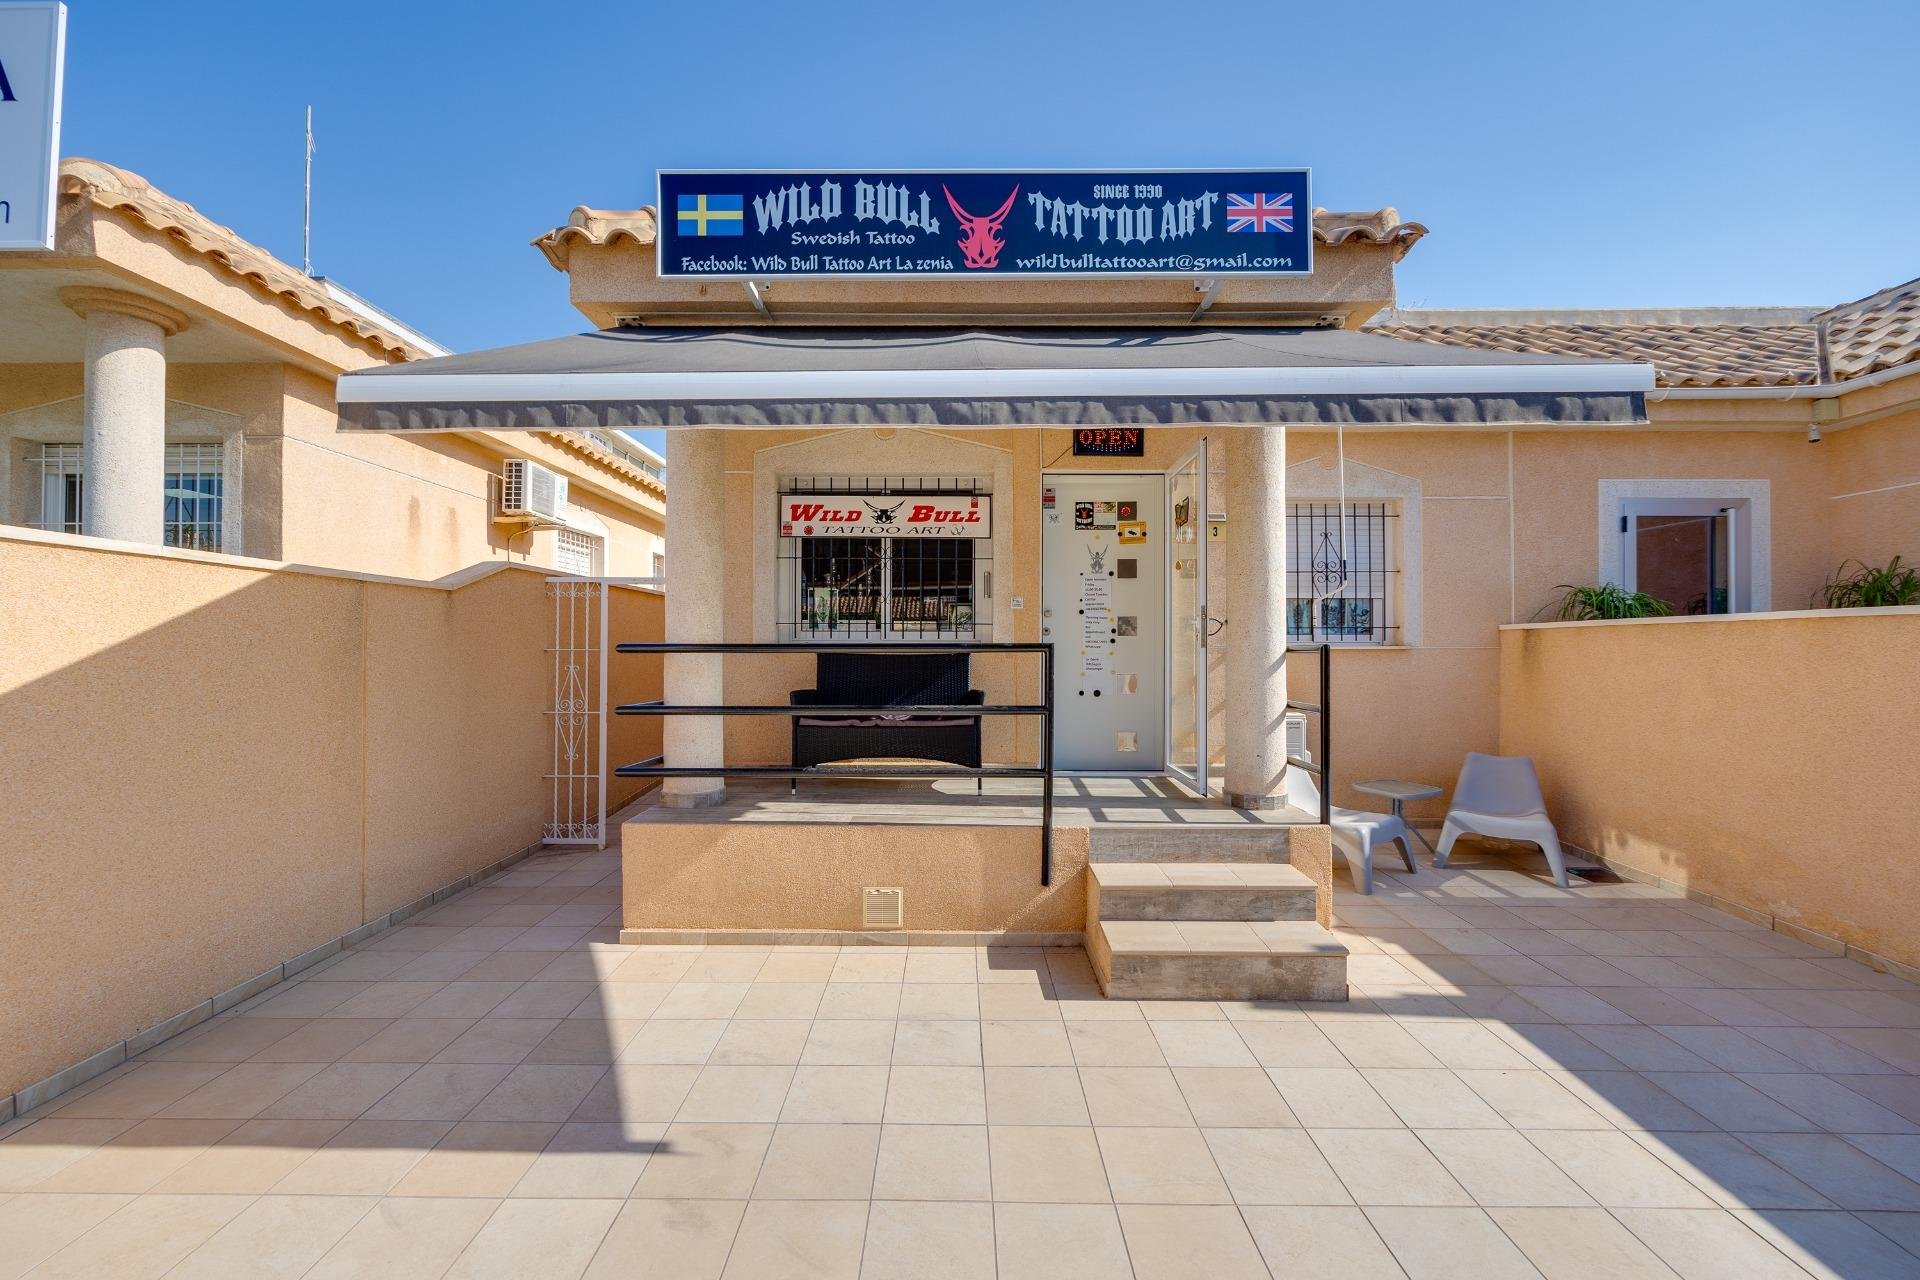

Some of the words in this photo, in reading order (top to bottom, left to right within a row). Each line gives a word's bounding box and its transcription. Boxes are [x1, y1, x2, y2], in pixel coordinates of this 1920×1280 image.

[1093, 183, 1130, 199] SINCE
[1133, 183, 1163, 199] 1990
[752, 178, 842, 236] WILD
[853, 178, 940, 235] BULL
[1027, 190, 1154, 246] TATTOO
[1159, 190, 1219, 243] ART
[791, 230, 861, 245] Swedish
[865, 230, 916, 245] Tattoo
[681, 255, 747, 271] Facebook:
[751, 255, 787, 271] Wild
[791, 255, 818, 271] Bull
[822, 256, 865, 271] Tattoo
[867, 255, 892, 271] Art
[895, 255, 914, 270] La
[916, 255, 954, 270] zenia
[1016, 252, 1293, 271] wildbulltattooart@gmail.com
[1079, 430, 1139, 445] OPEN
[822, 526, 901, 536] TATTOO
[906, 526, 946, 536] ART
[1212, 526, 1219, 537] 3
